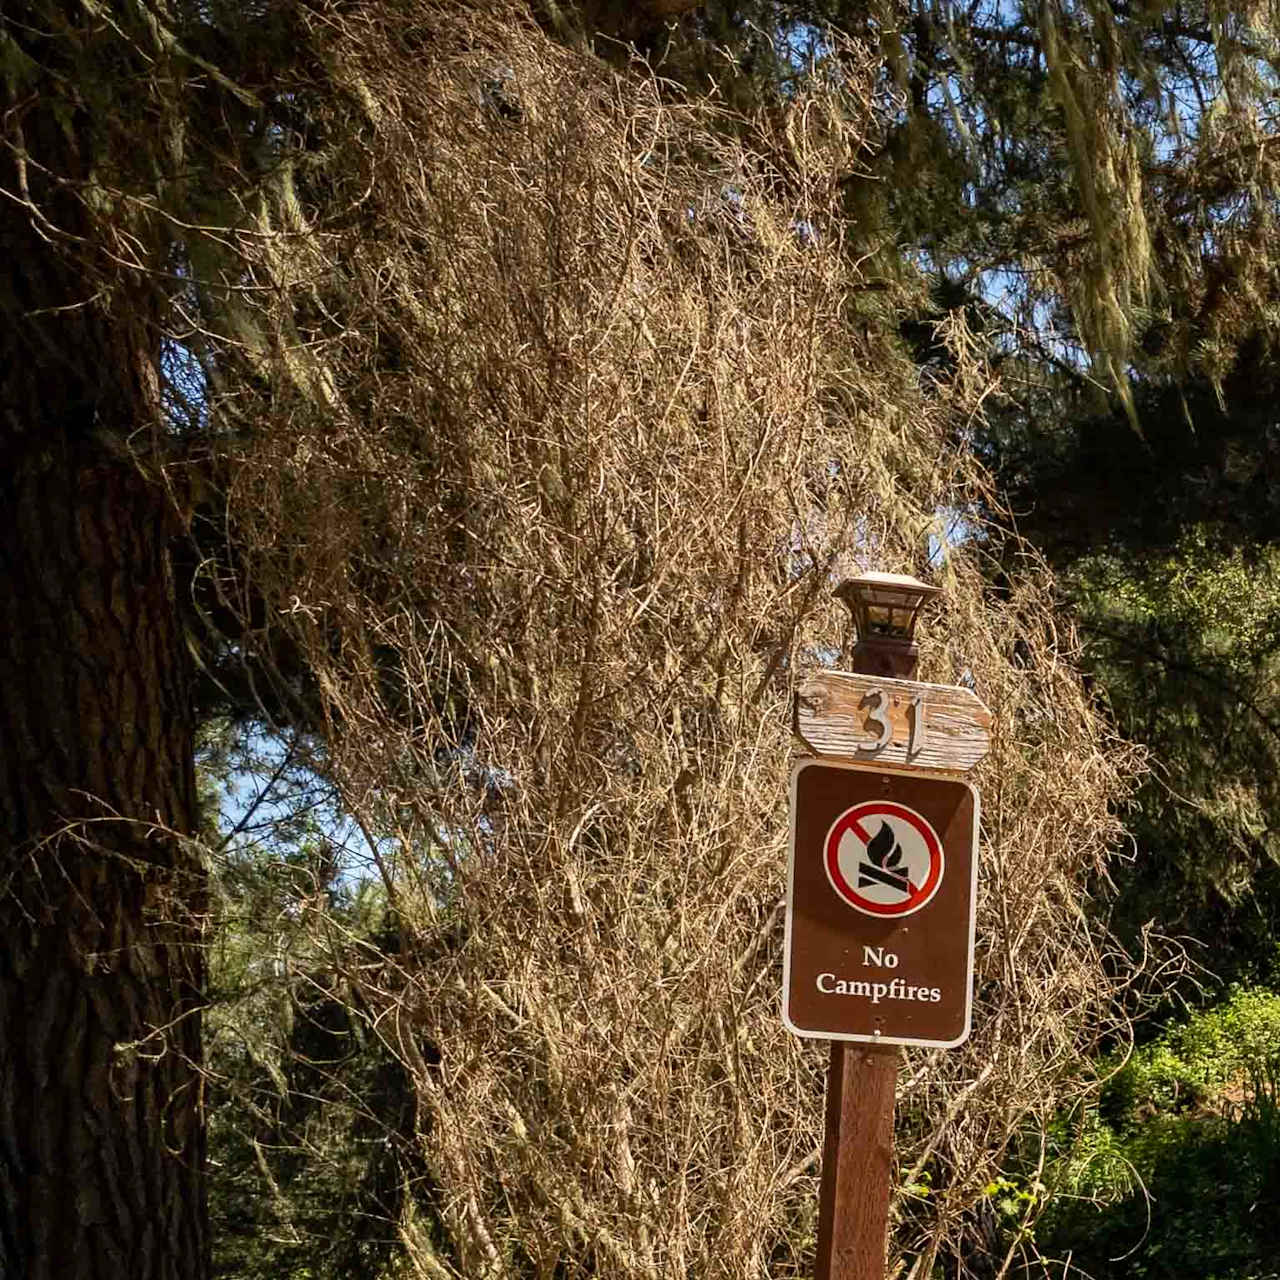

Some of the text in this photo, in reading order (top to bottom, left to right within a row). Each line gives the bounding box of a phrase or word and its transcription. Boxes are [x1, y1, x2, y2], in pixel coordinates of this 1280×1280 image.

[857, 687, 923, 754] 31
[862, 945, 899, 968] No
[816, 973, 942, 1003] Campfires
